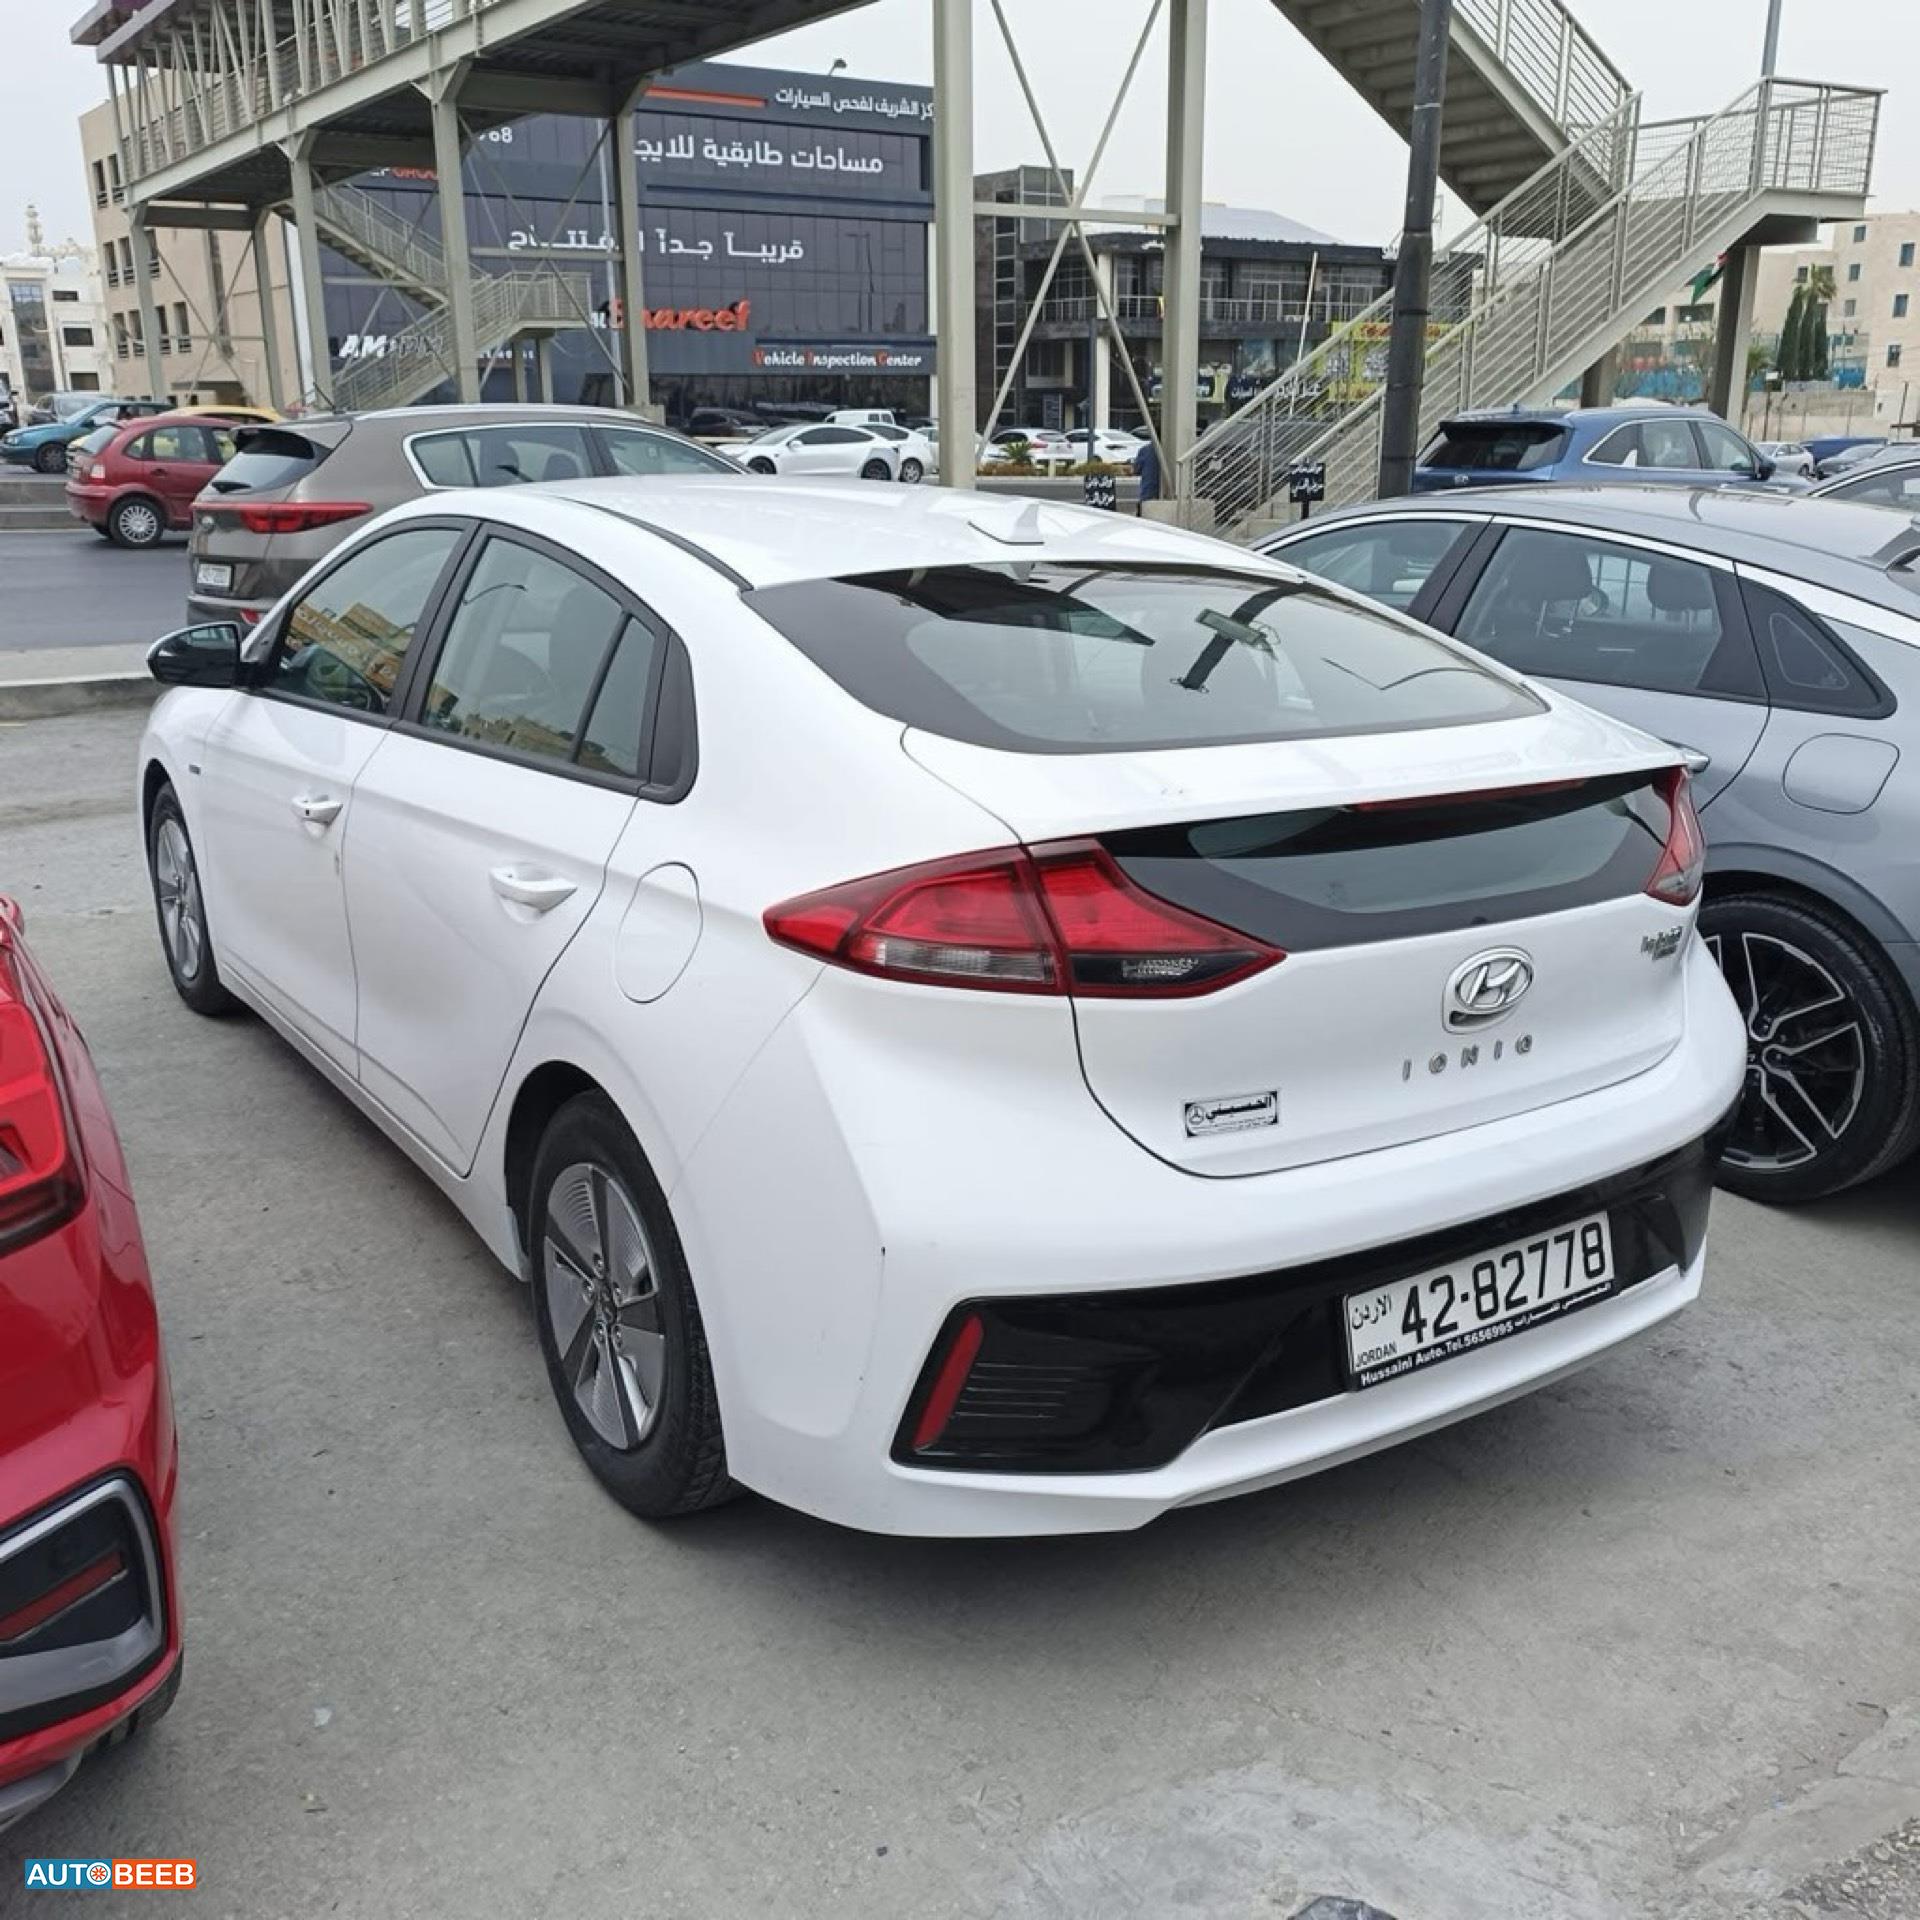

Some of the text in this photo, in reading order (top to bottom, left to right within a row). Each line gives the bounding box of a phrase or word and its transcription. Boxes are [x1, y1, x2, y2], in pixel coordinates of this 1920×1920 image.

[775, 87, 831, 109] السيارات
[833, 96, 873, 113] لفحص
[875, 97, 919, 118] الشريف
[633, 134, 883, 173] مساحات طابقية للايج
[753, 347, 922, 369] Vehicle Inspection Center
[1402, 1034, 1532, 1081] IONIQ
[1402, 1222, 1605, 1344] 42-82778
[1356, 1340, 1398, 1368] JORDAN
[1360, 1355, 1413, 1387] Hussaini
